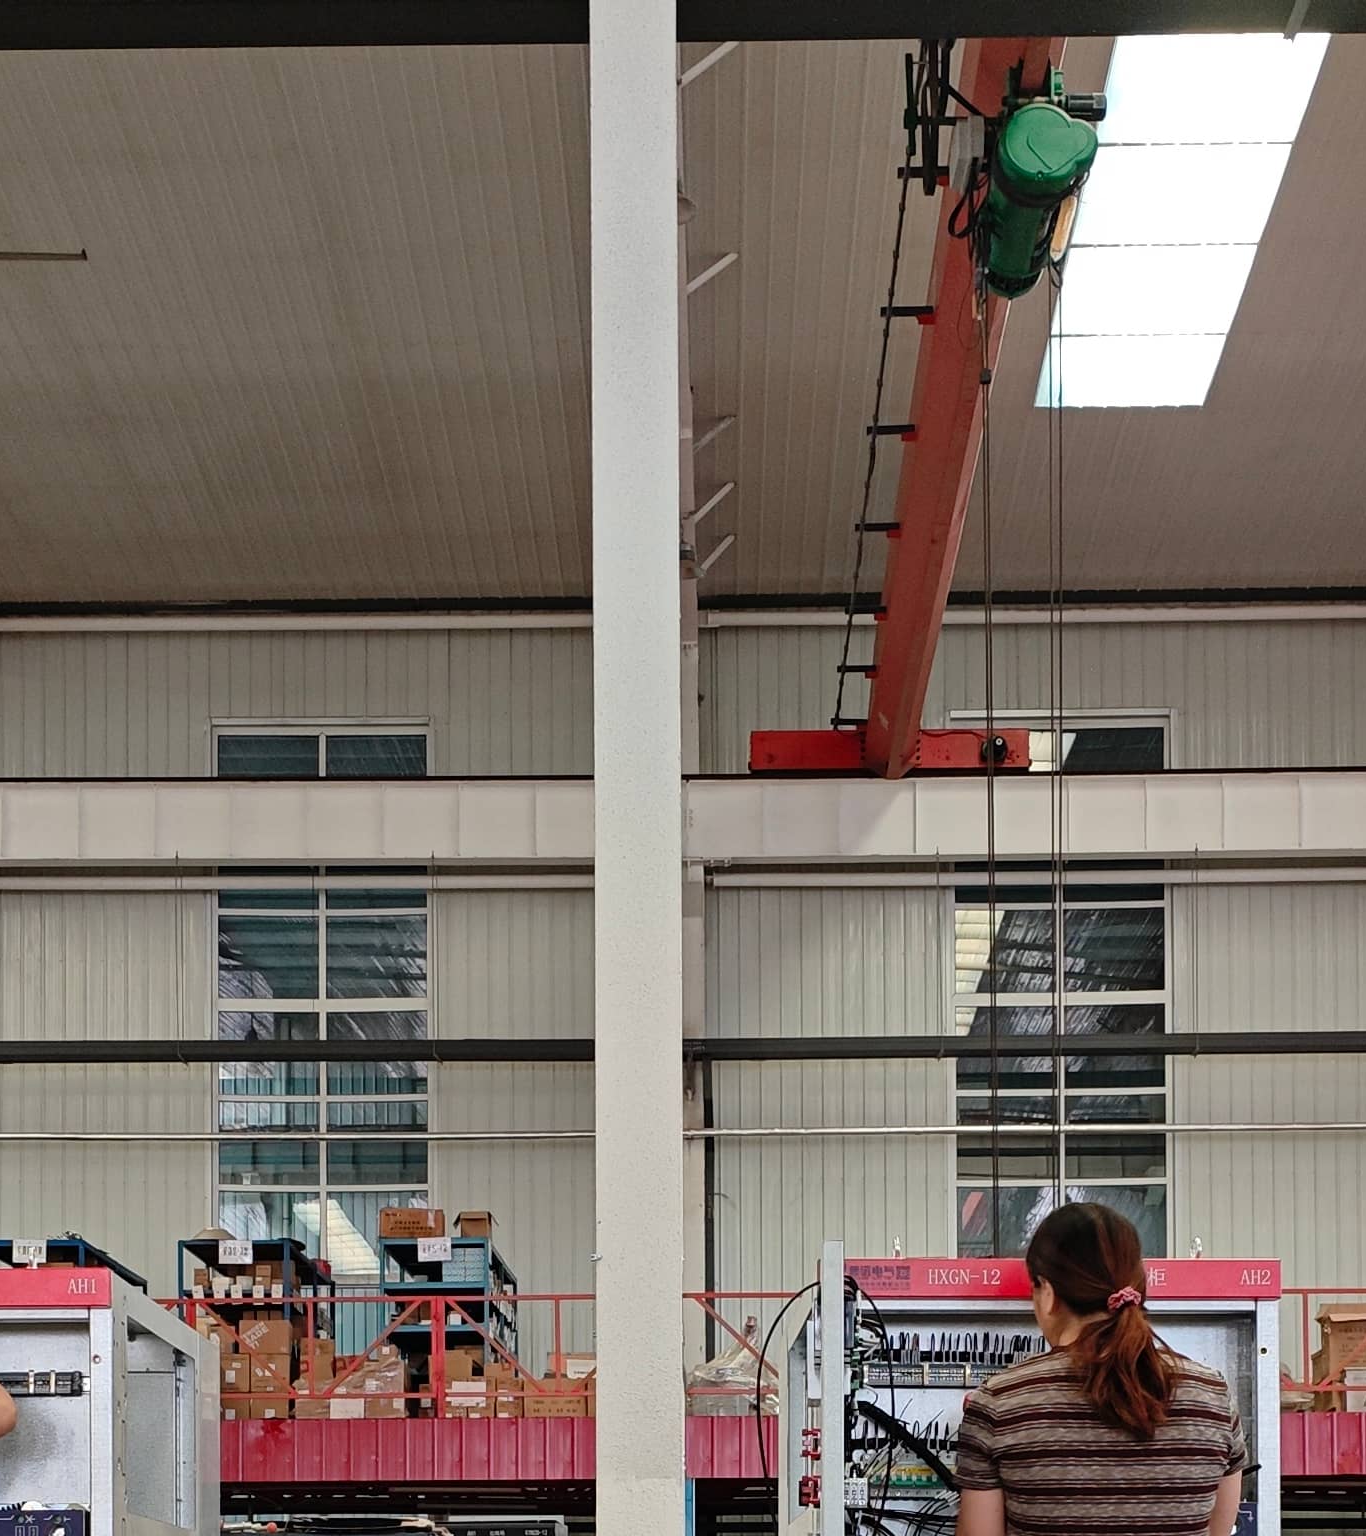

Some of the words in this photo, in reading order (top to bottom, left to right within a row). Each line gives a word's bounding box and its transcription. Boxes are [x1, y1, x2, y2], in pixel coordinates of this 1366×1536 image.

[928, 1269, 1001, 1285] HXGN-12
[1240, 1270, 1271, 1285] AH2
[67, 1278, 98, 1294] AH1
